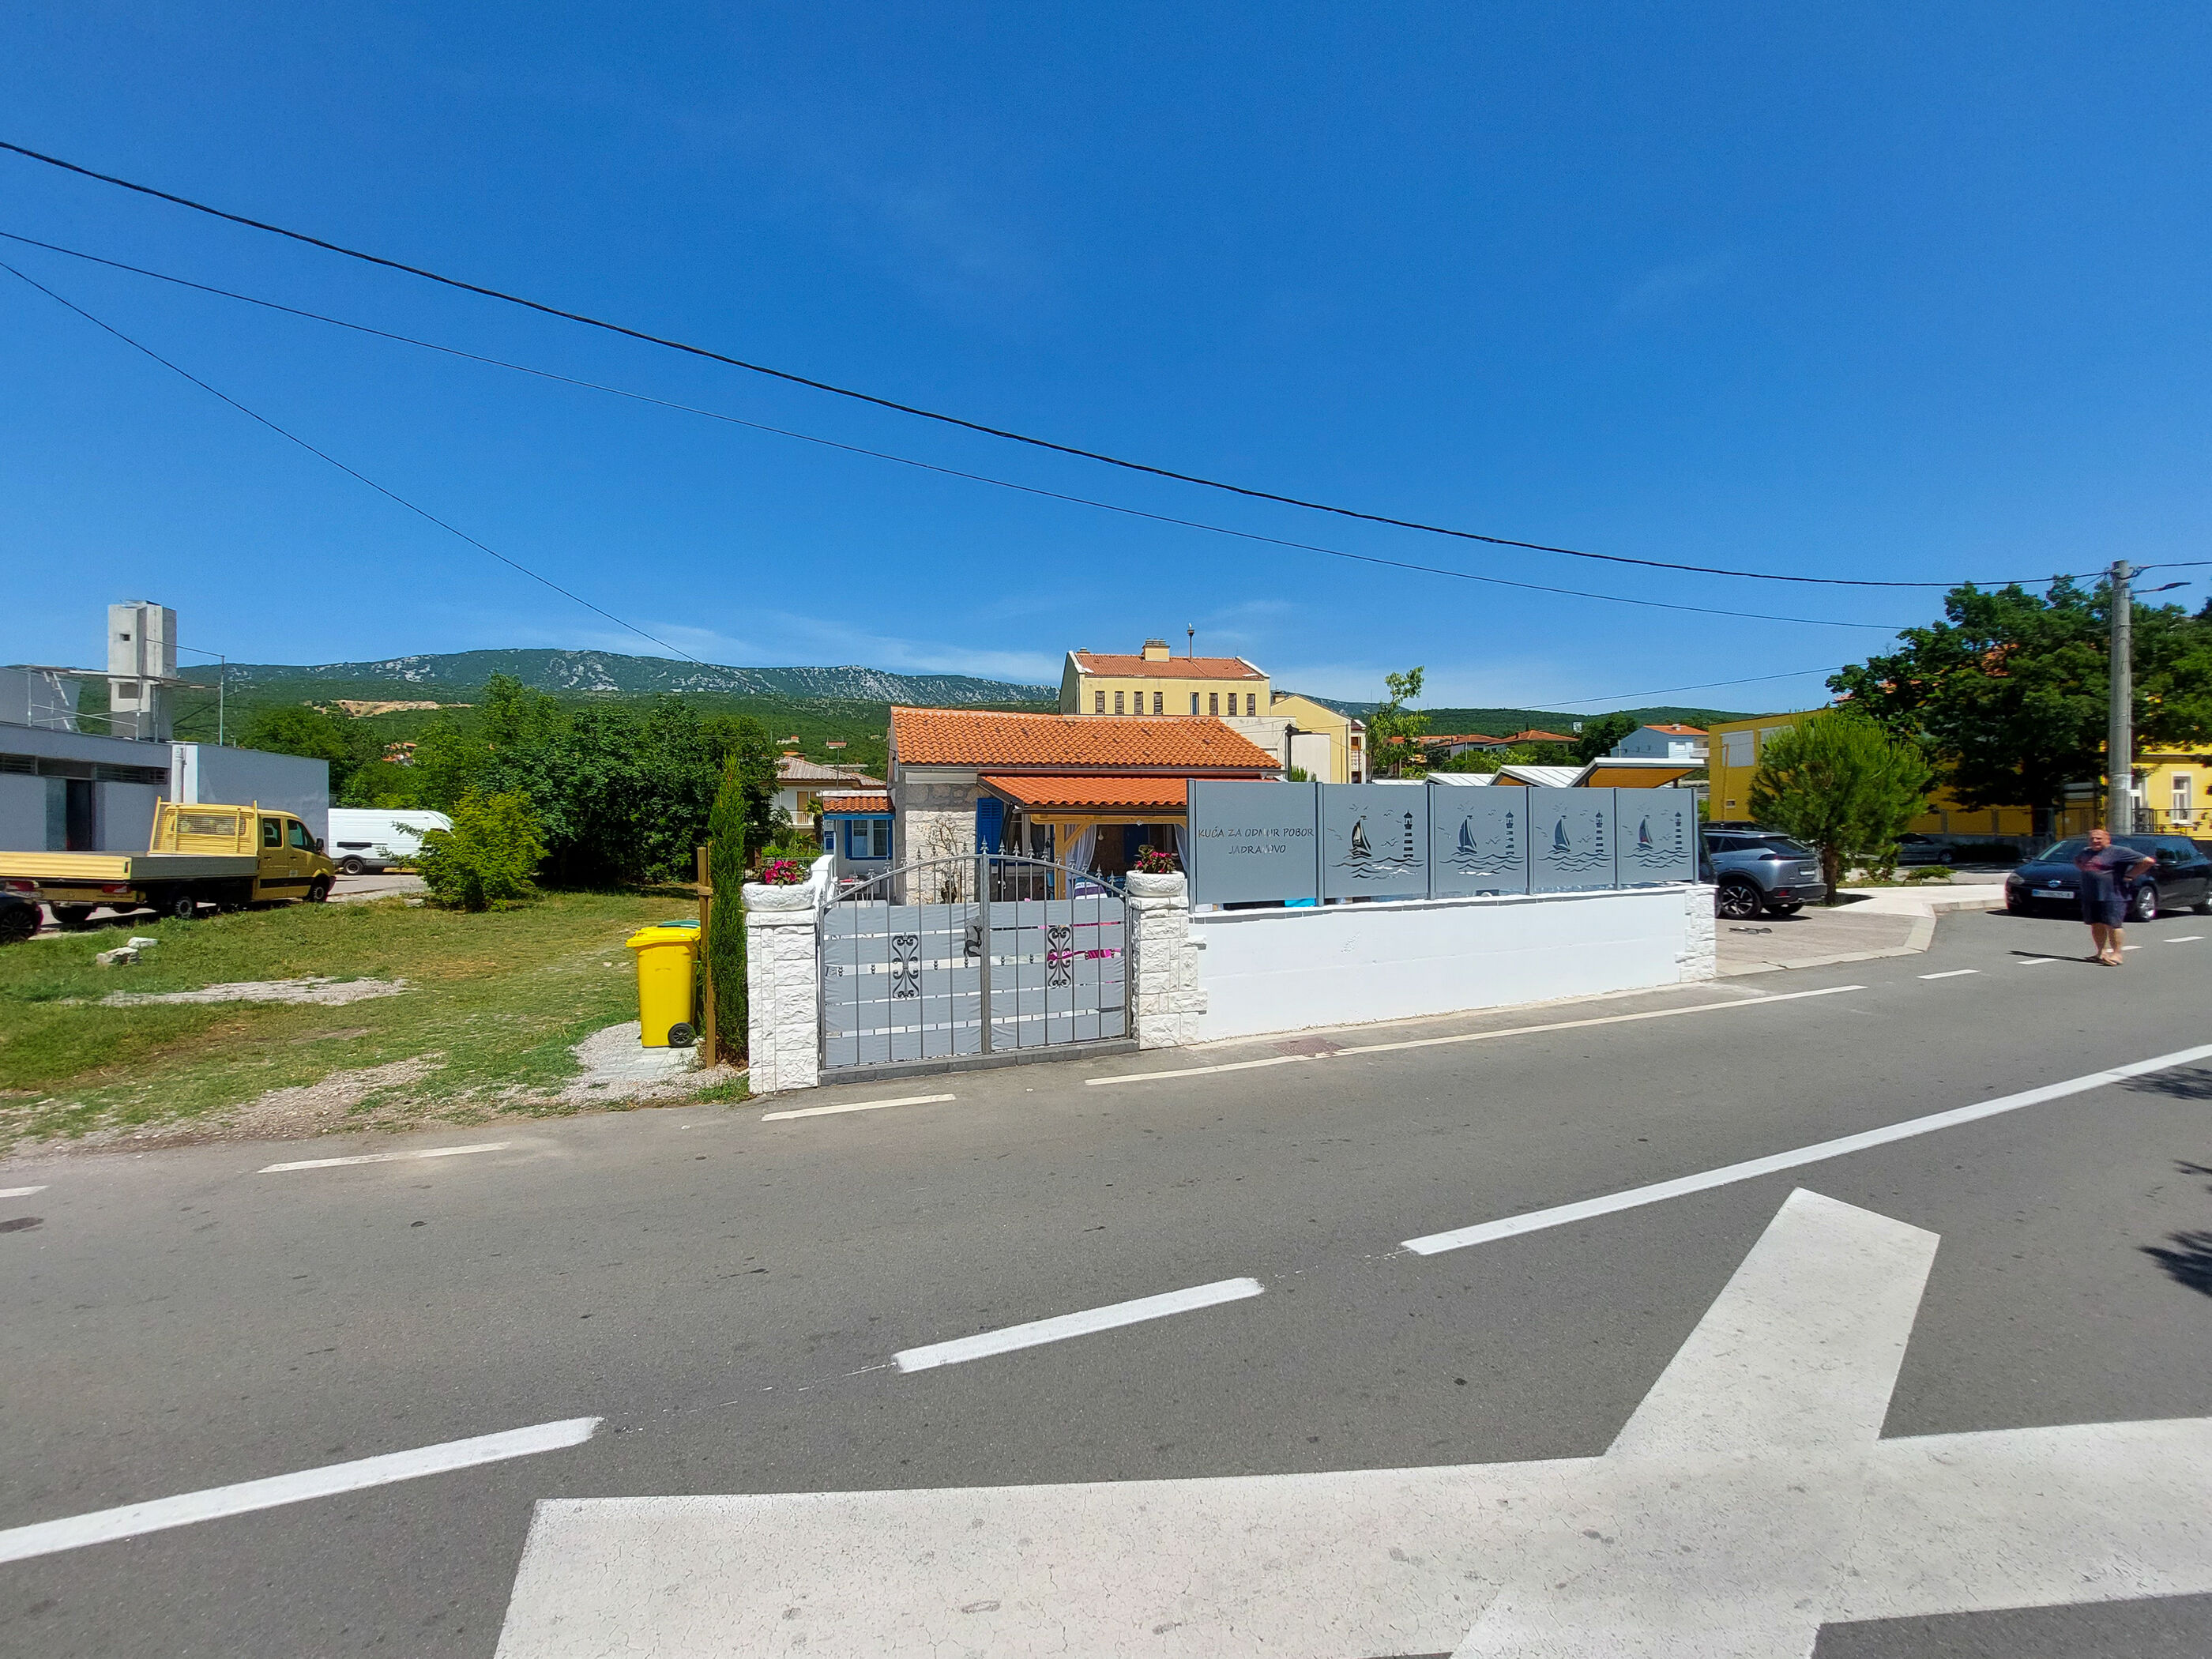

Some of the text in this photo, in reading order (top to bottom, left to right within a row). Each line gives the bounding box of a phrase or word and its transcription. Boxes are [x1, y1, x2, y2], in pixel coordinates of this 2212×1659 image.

[1198, 826, 1224, 838] KUĆA
[1228, 828, 1243, 837] ZA
[1283, 828, 1315, 837] POBOR
